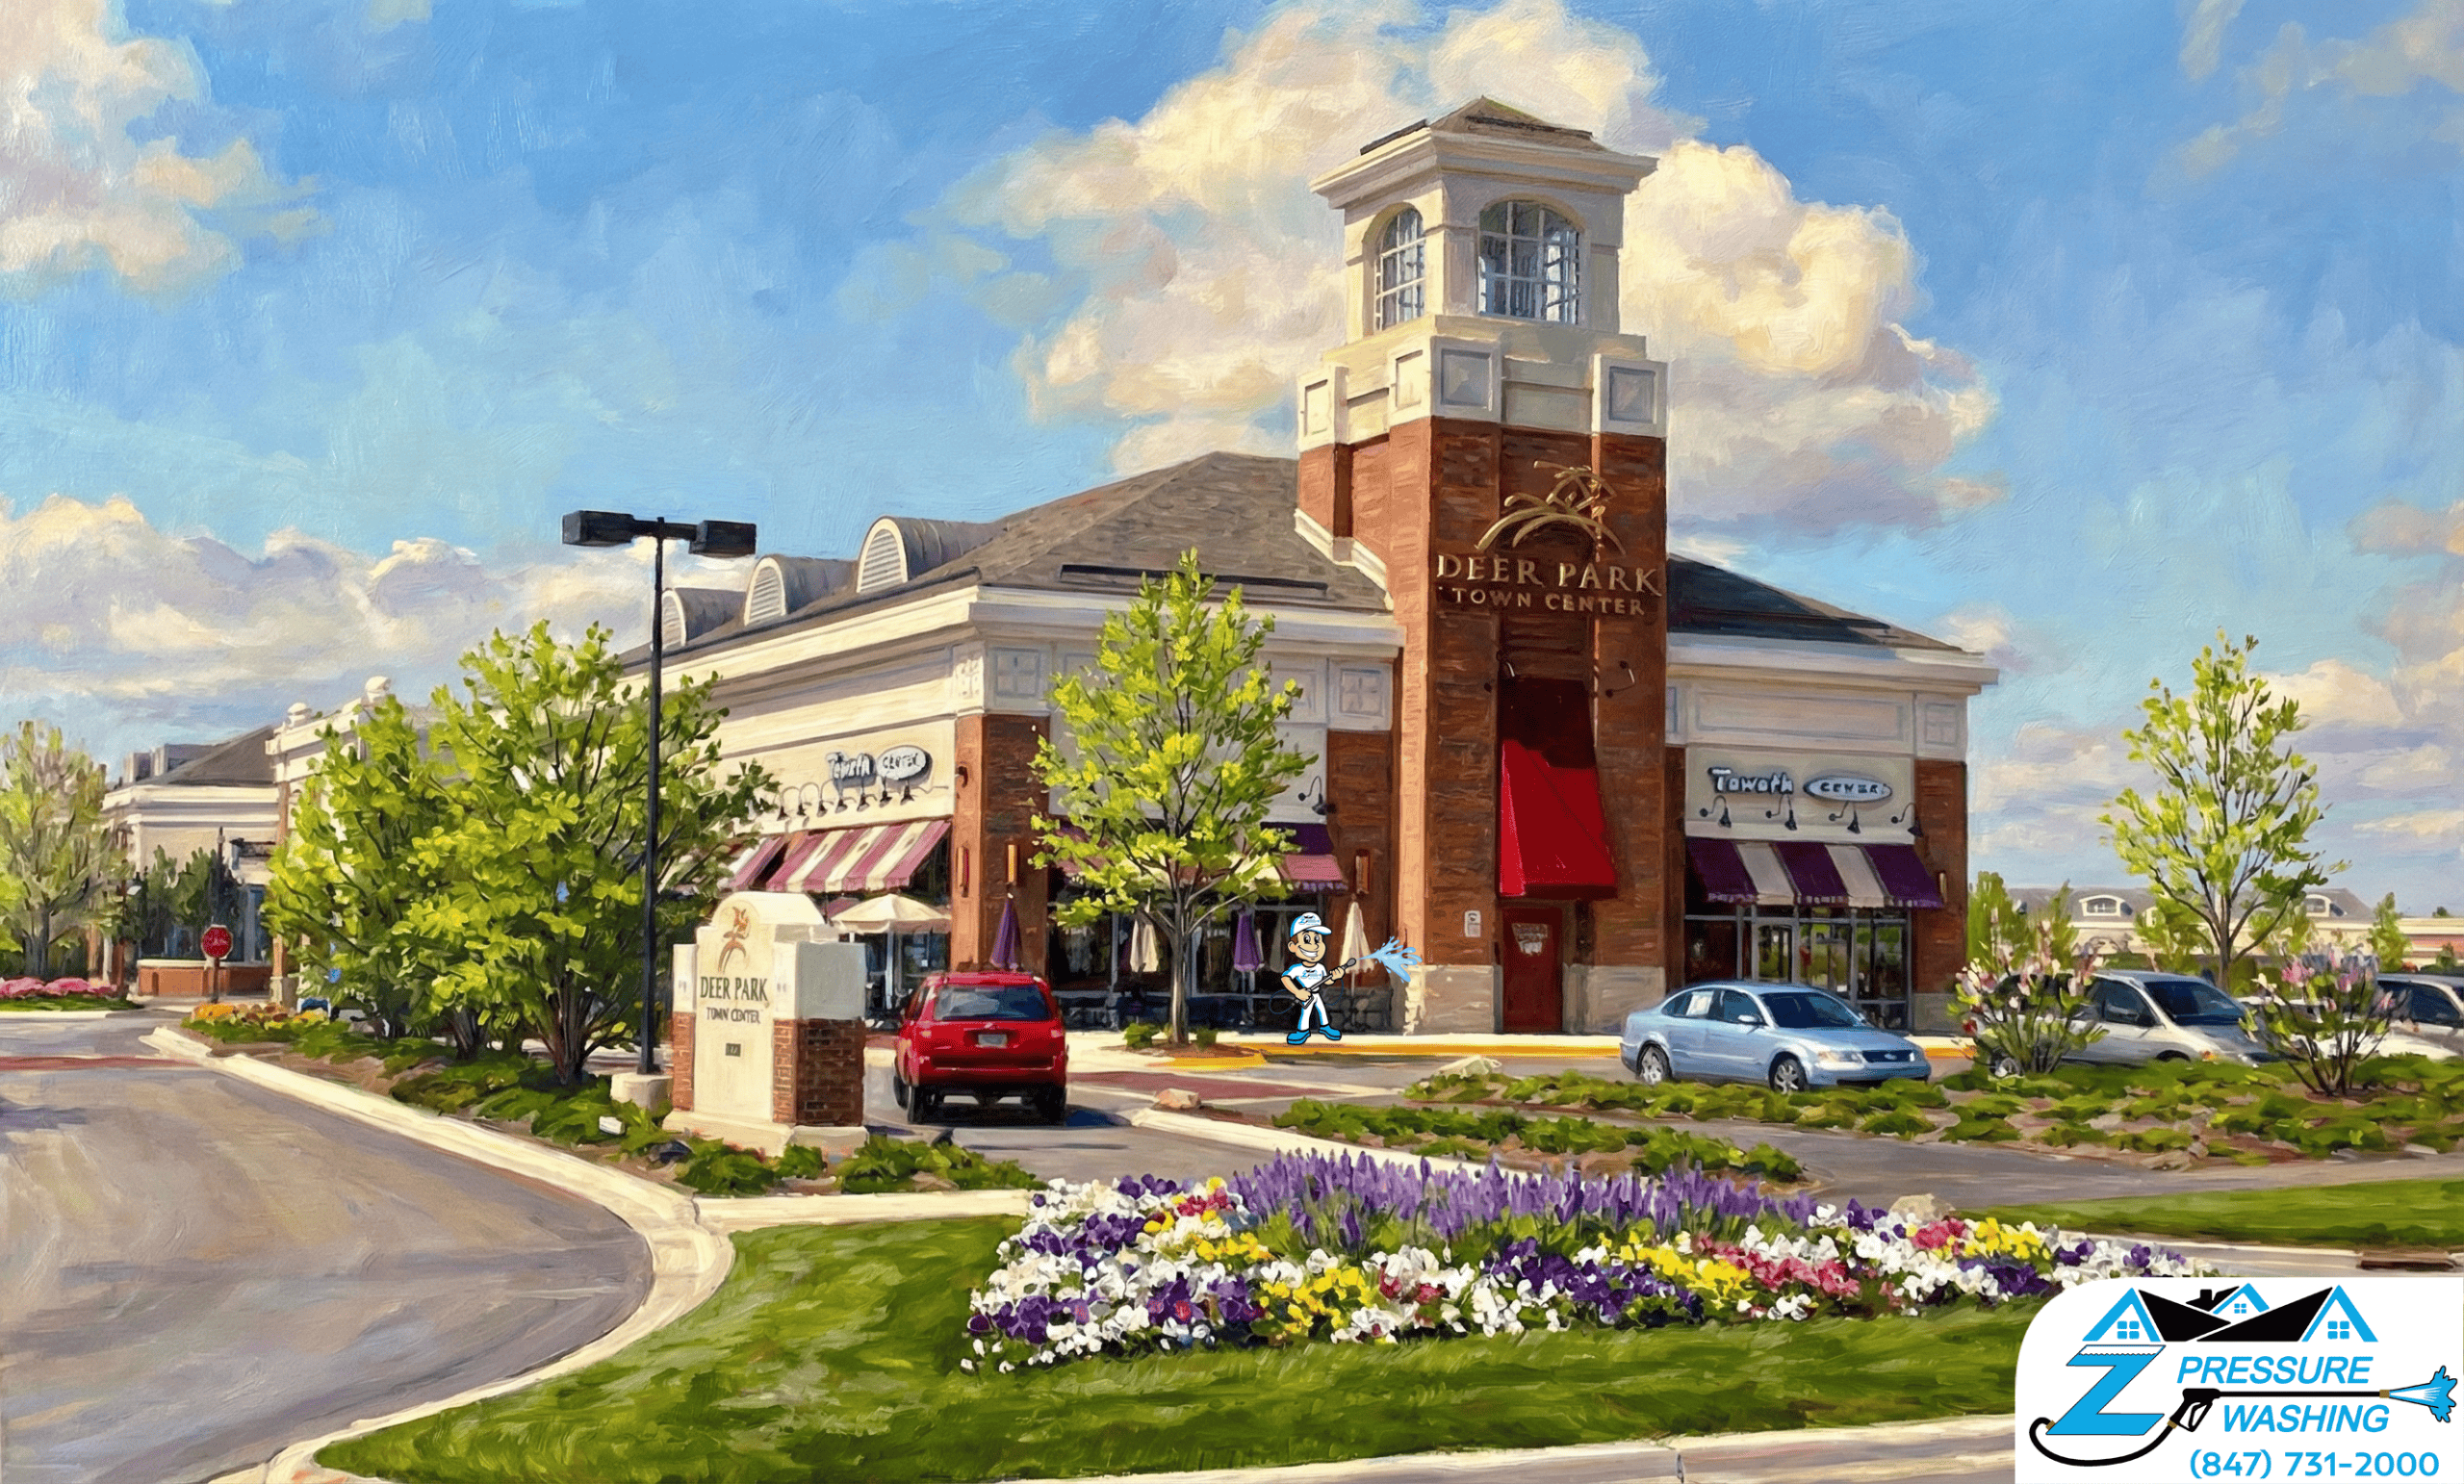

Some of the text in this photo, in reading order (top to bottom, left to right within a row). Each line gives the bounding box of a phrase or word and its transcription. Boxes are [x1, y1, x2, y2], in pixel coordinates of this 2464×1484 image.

[1437, 553, 1662, 597] DEER PARK
[1452, 586, 1645, 616] TOWN CENTER
[700, 976, 768, 1002] DEER PARK
